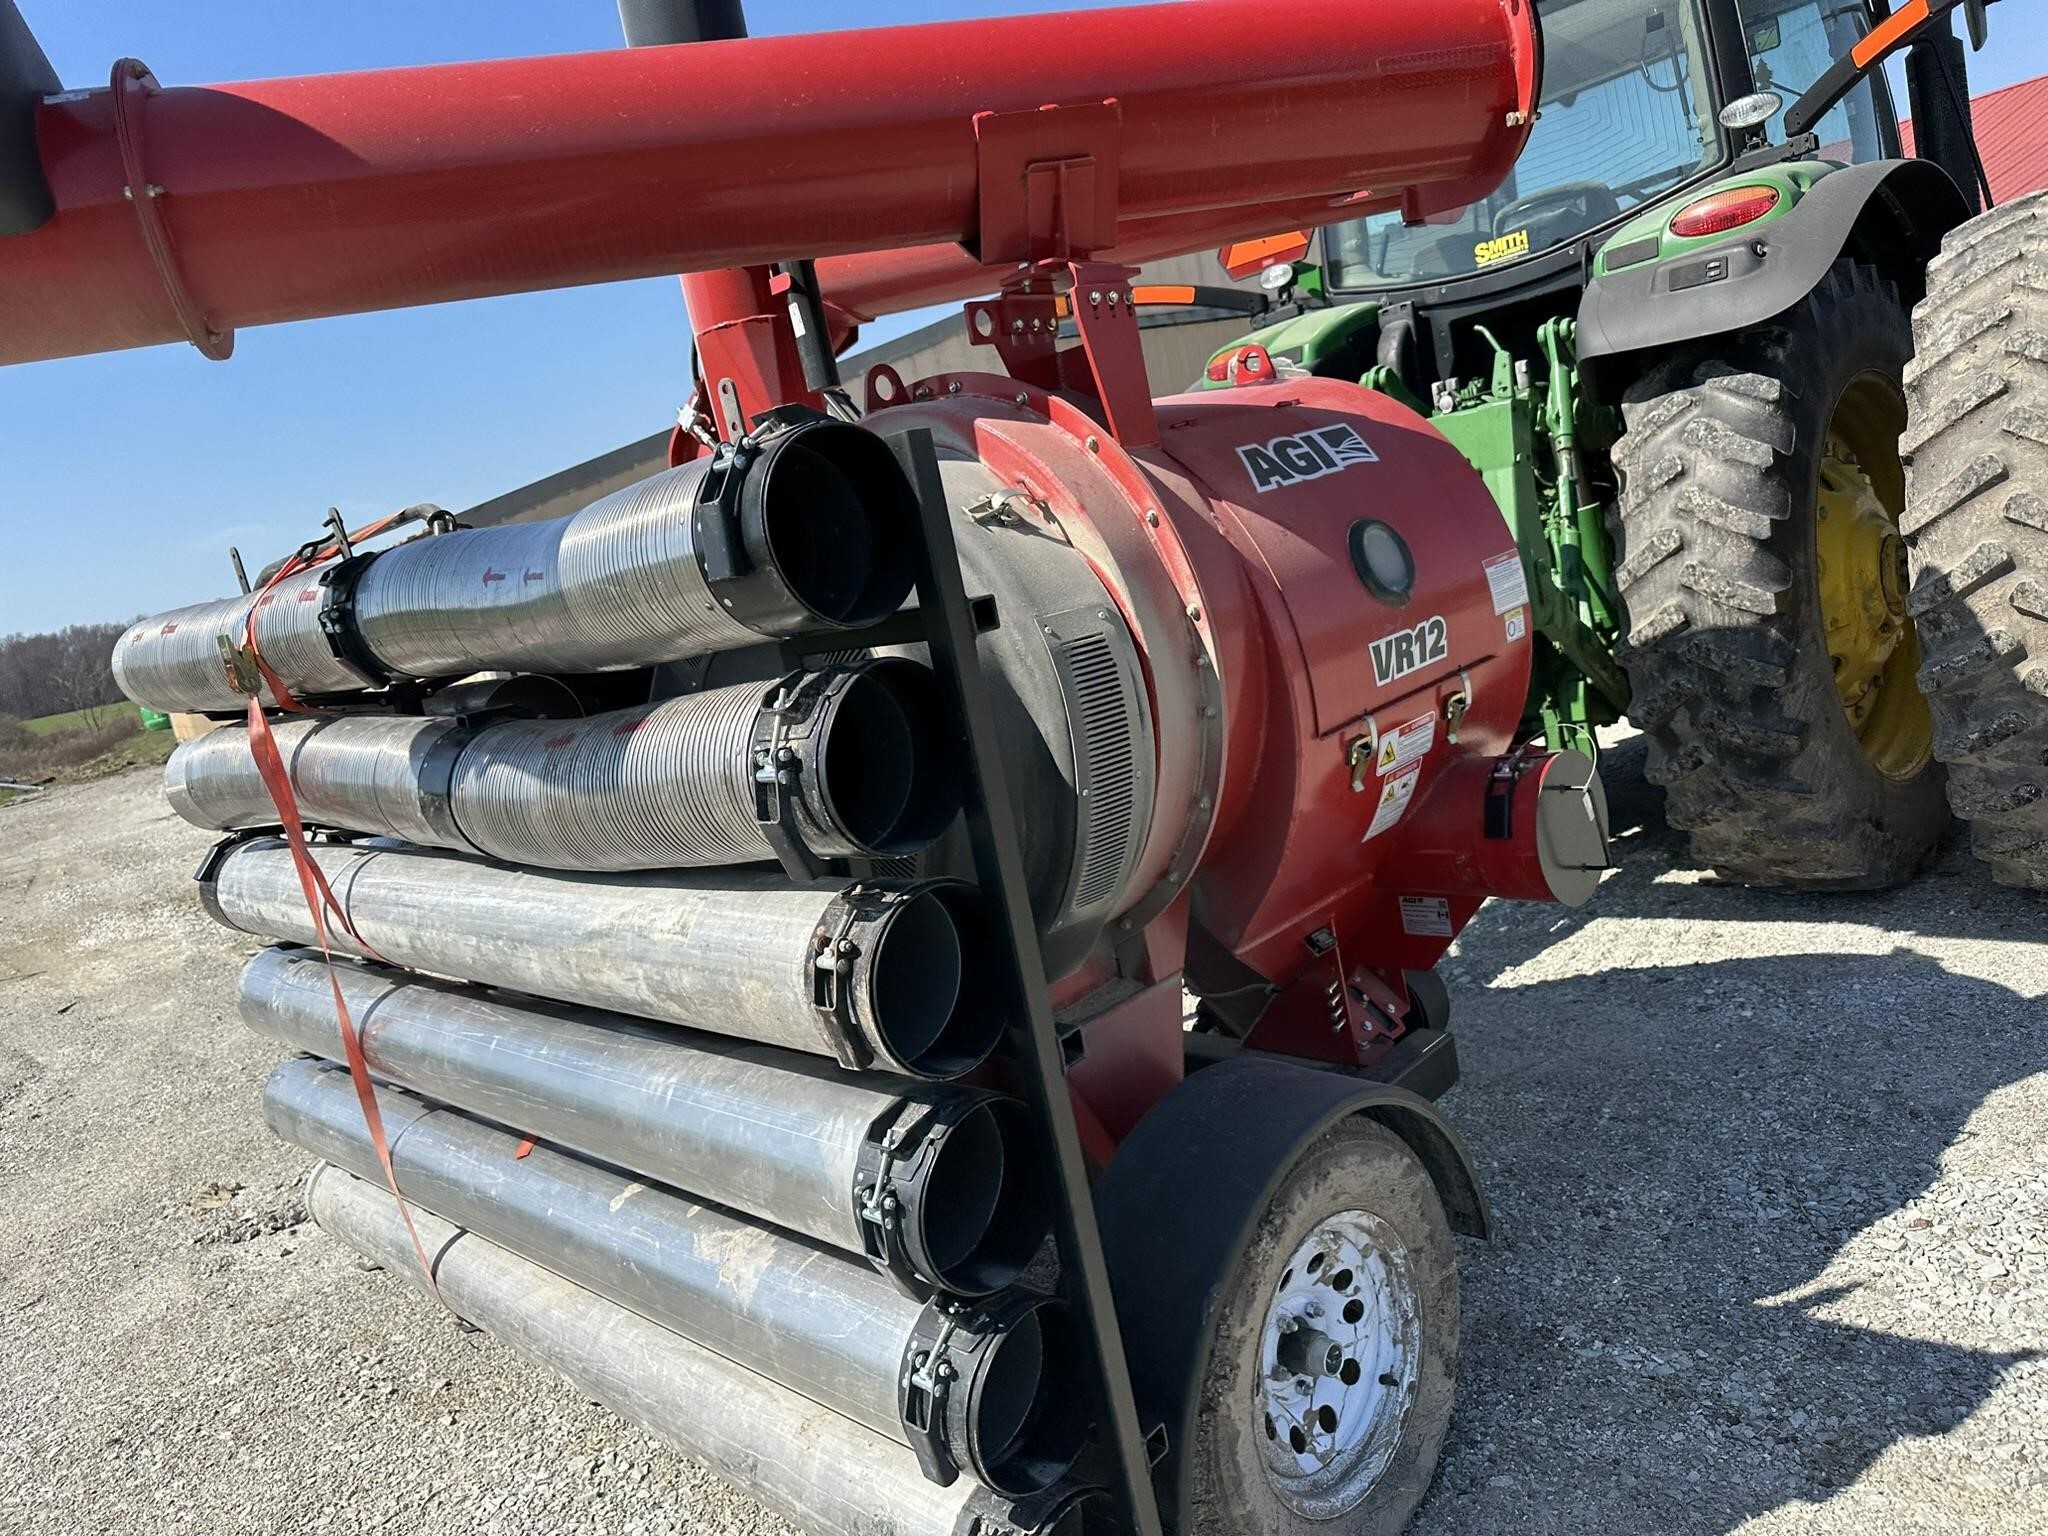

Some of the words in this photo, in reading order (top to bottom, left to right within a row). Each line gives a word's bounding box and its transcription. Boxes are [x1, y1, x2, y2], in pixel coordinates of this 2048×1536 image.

[1474, 229, 1528, 264] SMITH
[1240, 433, 1339, 488] AGI
[1371, 618, 1446, 682] VR12
